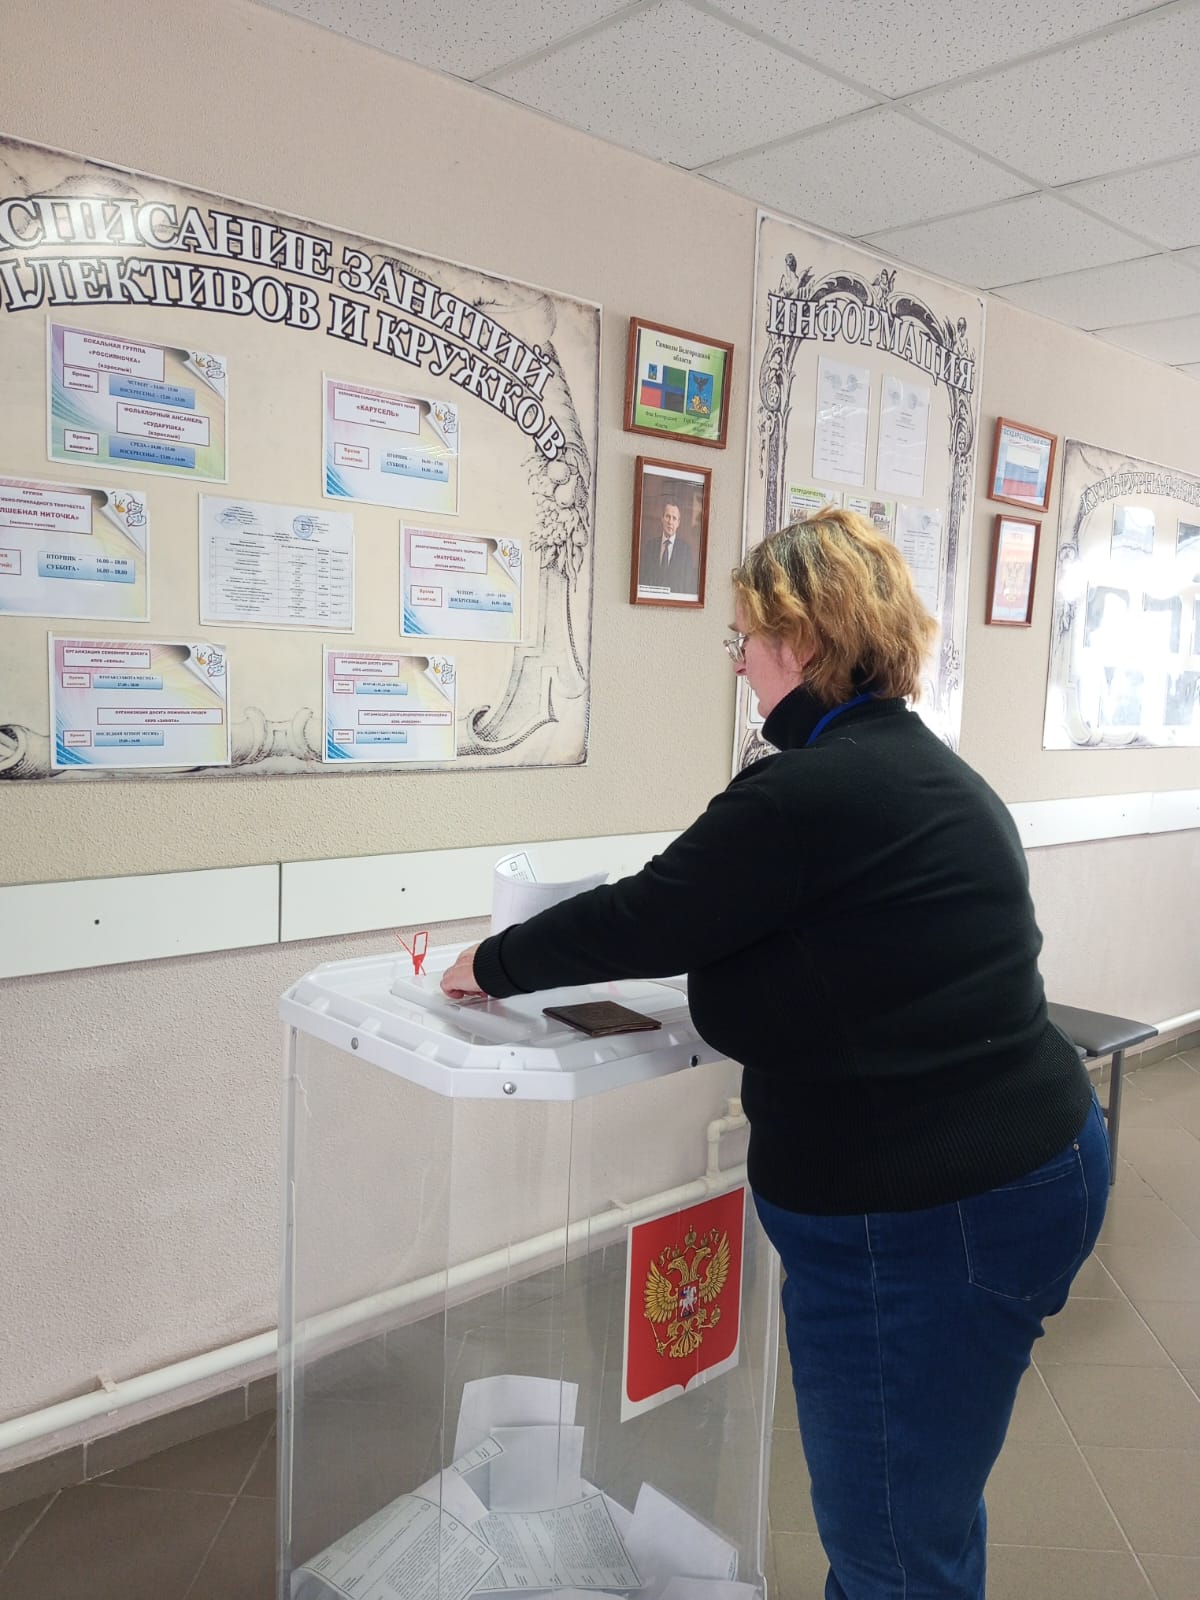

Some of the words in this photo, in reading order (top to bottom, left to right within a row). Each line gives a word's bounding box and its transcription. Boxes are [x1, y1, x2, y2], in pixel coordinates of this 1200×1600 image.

[0, 195, 334, 283] СПИСАНИЕ
[338, 247, 555, 398] ЗАНЯТИЙ
[766, 293, 975, 393] ИНФОРМАЦИЯ
[326, 293, 370, 347] И
[373, 311, 568, 461] КРУЖКОВ
[356, 404, 399, 418] «КАРУСЕЛЬ»
[1081, 471, 1171, 515] КУЛЬТУРНАЯ
